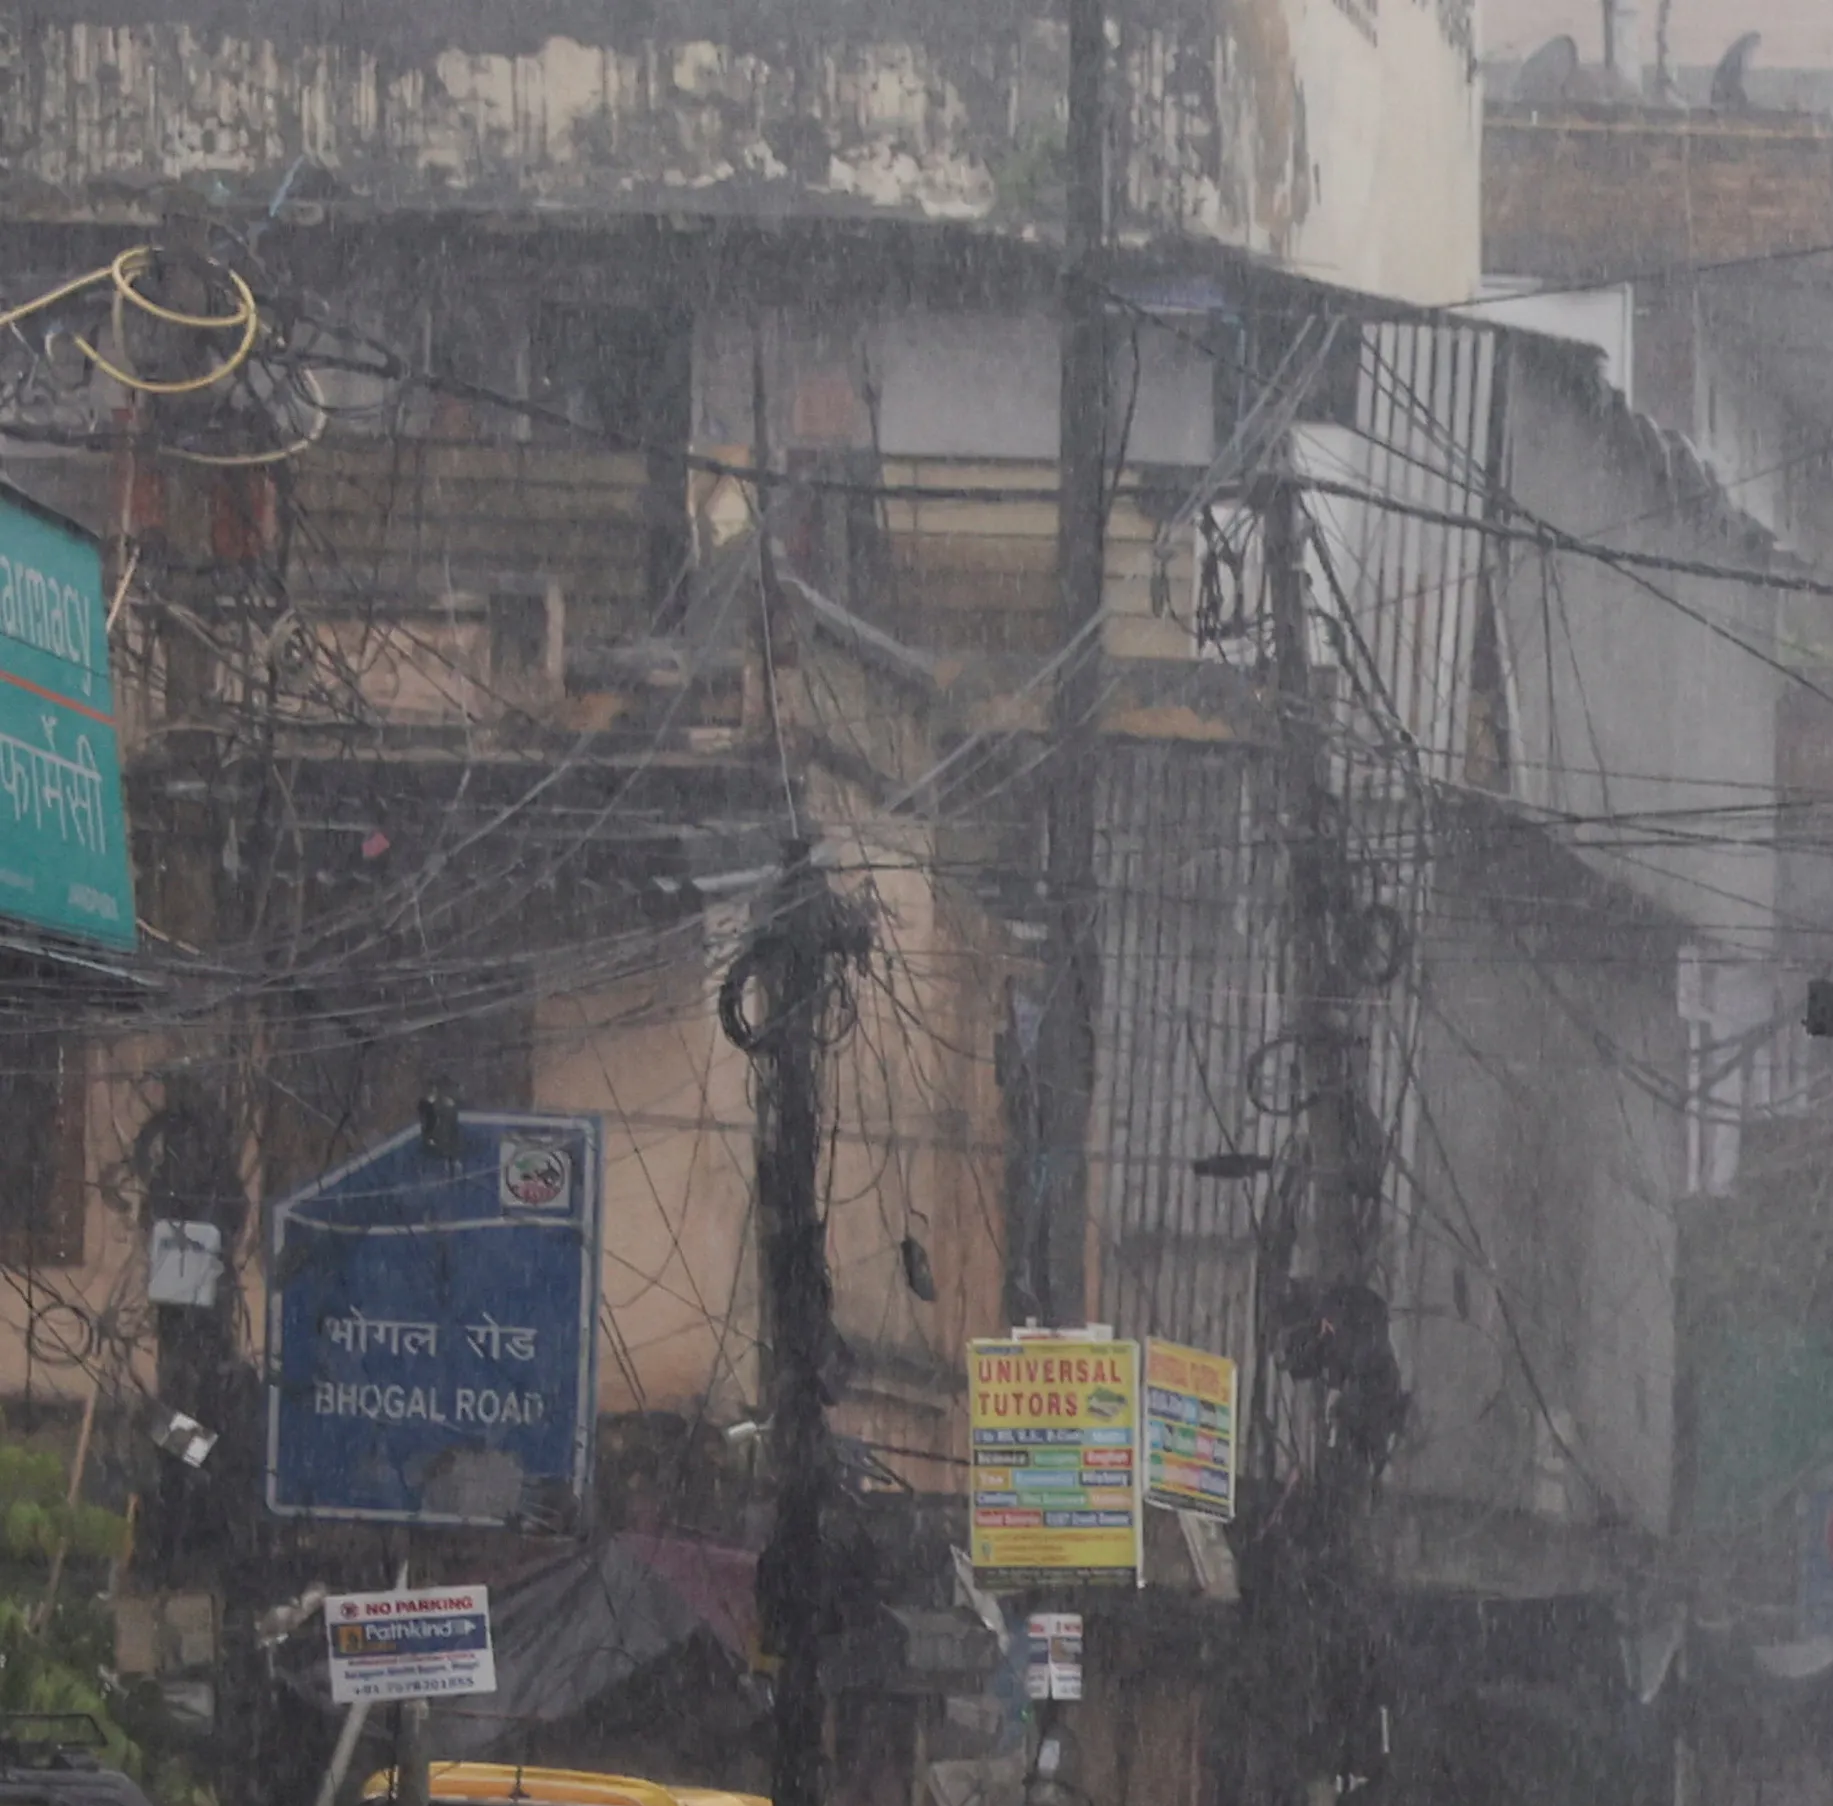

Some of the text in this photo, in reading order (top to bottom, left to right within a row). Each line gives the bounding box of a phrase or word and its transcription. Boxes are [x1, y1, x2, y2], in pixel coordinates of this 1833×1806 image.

[324, 1306, 538, 1361] भोगल रोड
[978, 1359, 1121, 1383] UNIVERSAL
[314, 1381, 544, 1424] BHOGAL ROAD
[978, 1392, 1078, 1417] TUTORS
[366, 1596, 474, 1616] NO PARKING
[365, 1618, 452, 1641] Pathkind
